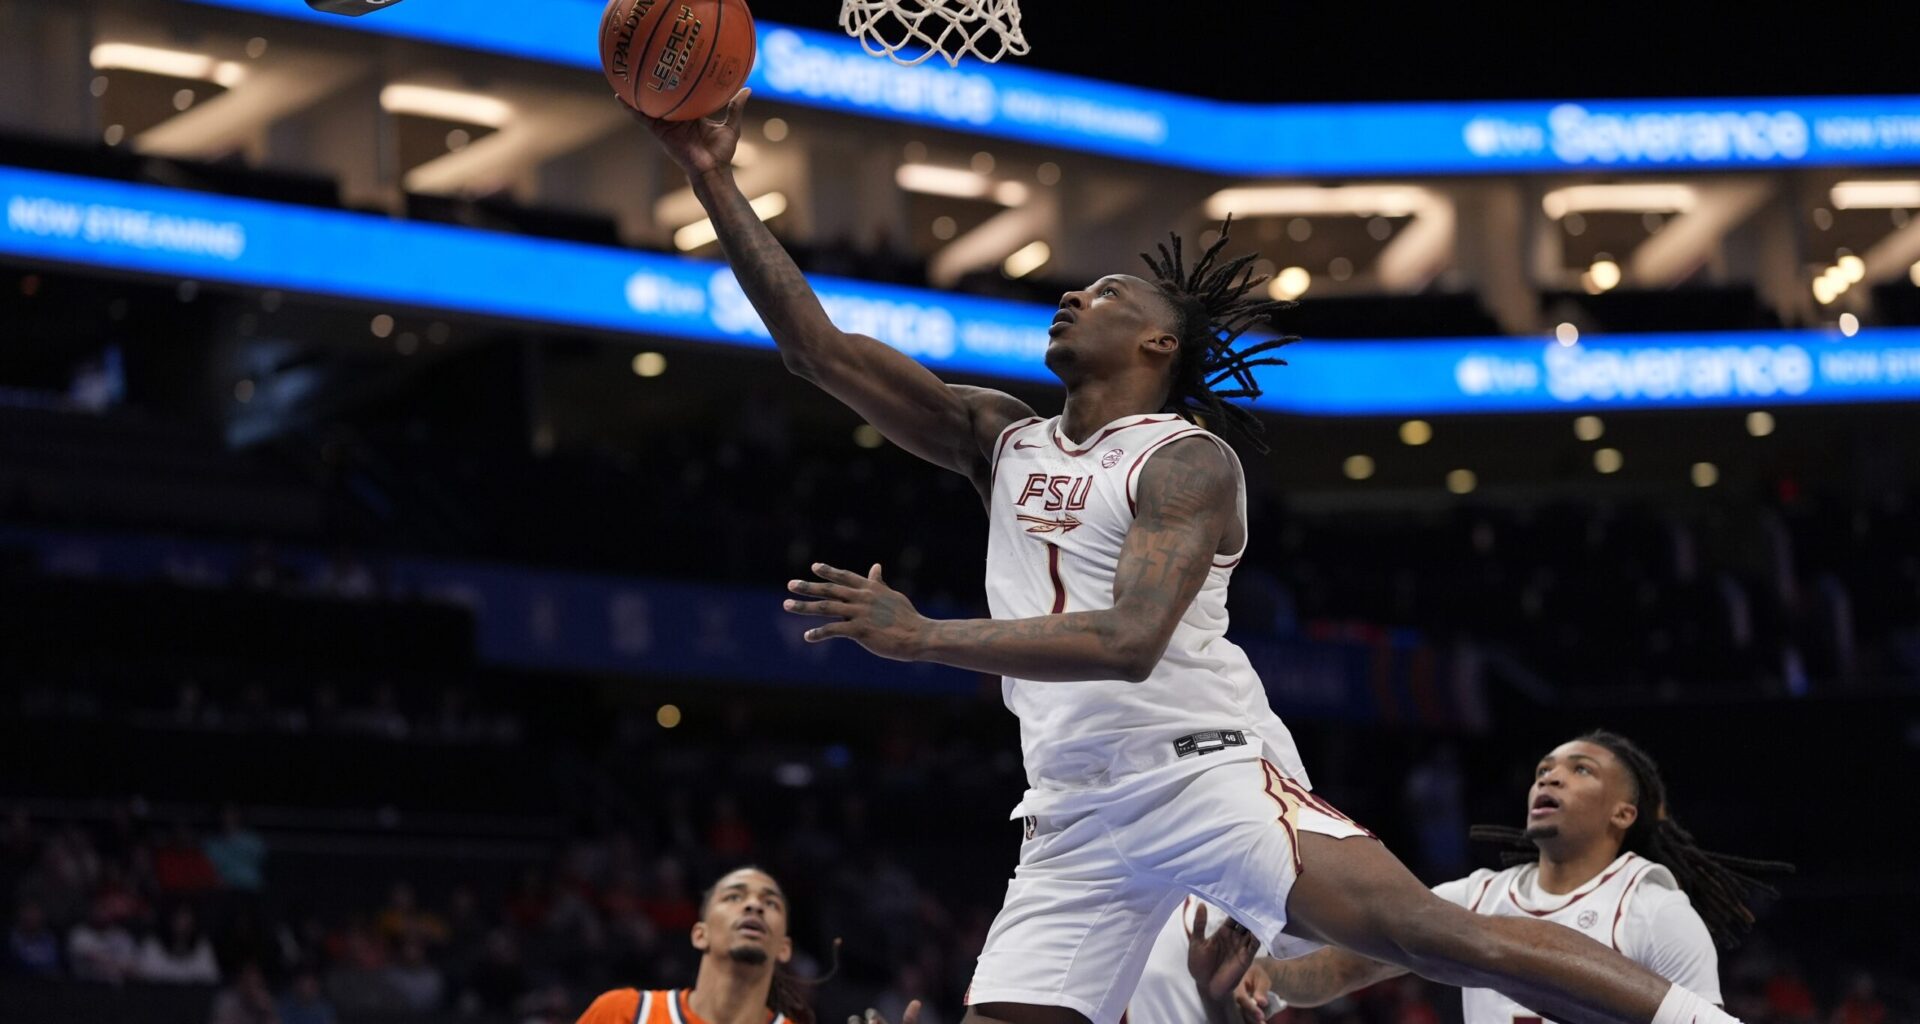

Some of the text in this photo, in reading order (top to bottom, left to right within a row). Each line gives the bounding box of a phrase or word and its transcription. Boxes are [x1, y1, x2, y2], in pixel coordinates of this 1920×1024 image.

[612, 0, 655, 83] SPALDIN
[647, 4, 696, 93] LEGACY
[673, 18, 702, 73] 1000
[762, 28, 999, 125] Severance
[1548, 103, 1808, 164] Severance
[8, 196, 246, 260] NOW STREAMING
[1545, 339, 1813, 401] Severance
[1016, 472, 1094, 512] FSU
[1046, 543, 1068, 614] 1
